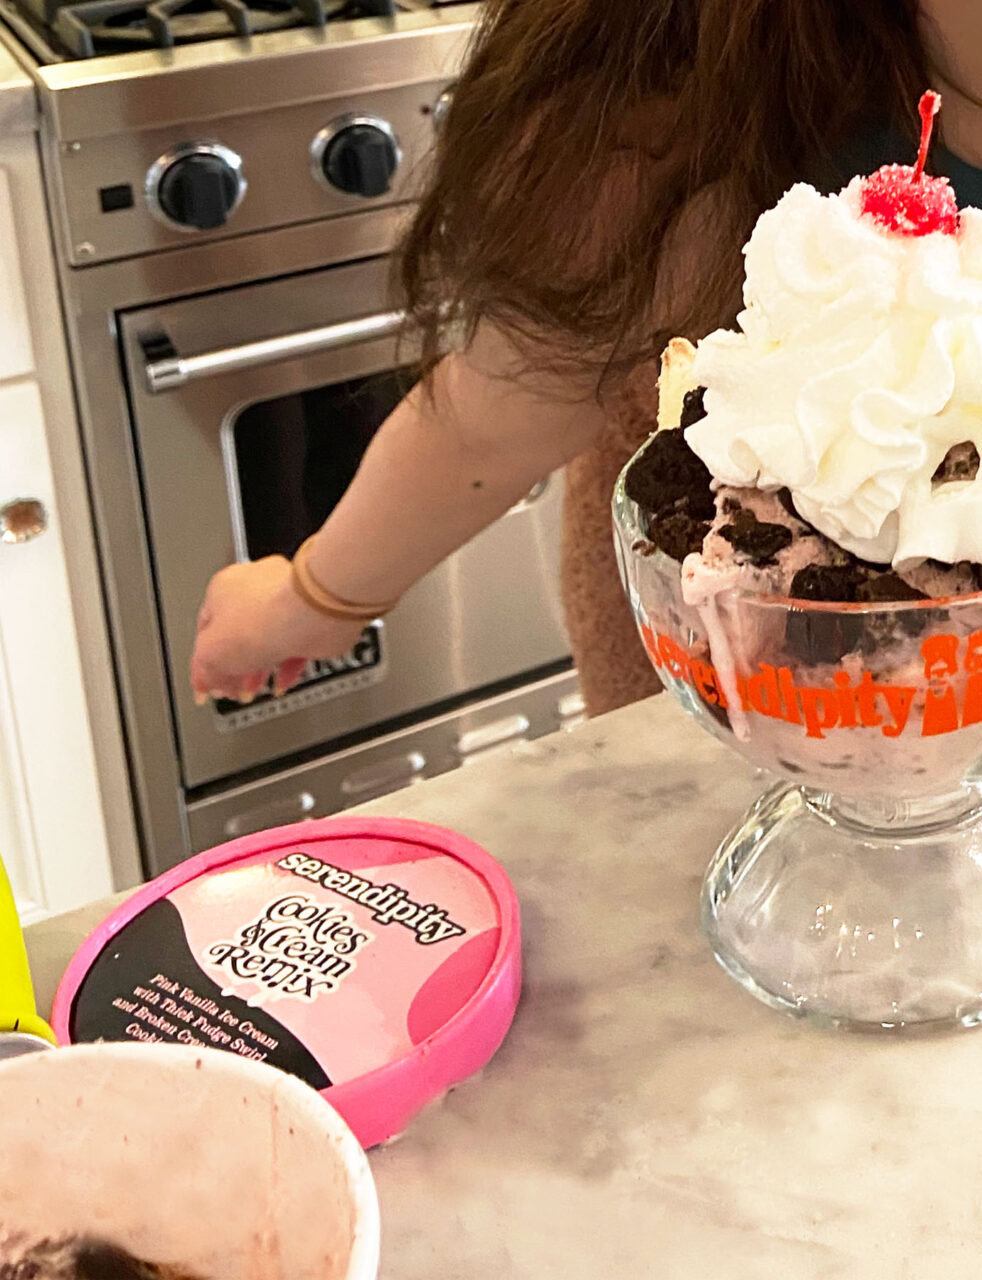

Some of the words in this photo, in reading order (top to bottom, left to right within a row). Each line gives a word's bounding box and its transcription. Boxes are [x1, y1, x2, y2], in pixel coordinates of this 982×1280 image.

[266, 895, 368, 955] Cookies
[275, 852, 466, 945] serendipity
[209, 943, 333, 998] Remix
[112, 997, 136, 1013] and
[134, 1006, 178, 1035] Broken
[132, 986, 161, 1005] with
[160, 997, 195, 1023] Thick
[192, 1015, 232, 1044] Fudge
[230, 1038, 268, 1062] Swirl
[149, 973, 180, 995] Pink
[179, 987, 220, 1016] Vanilla
[218, 1009, 239, 1026] Ice
[238, 1021, 279, 1051] Cream
